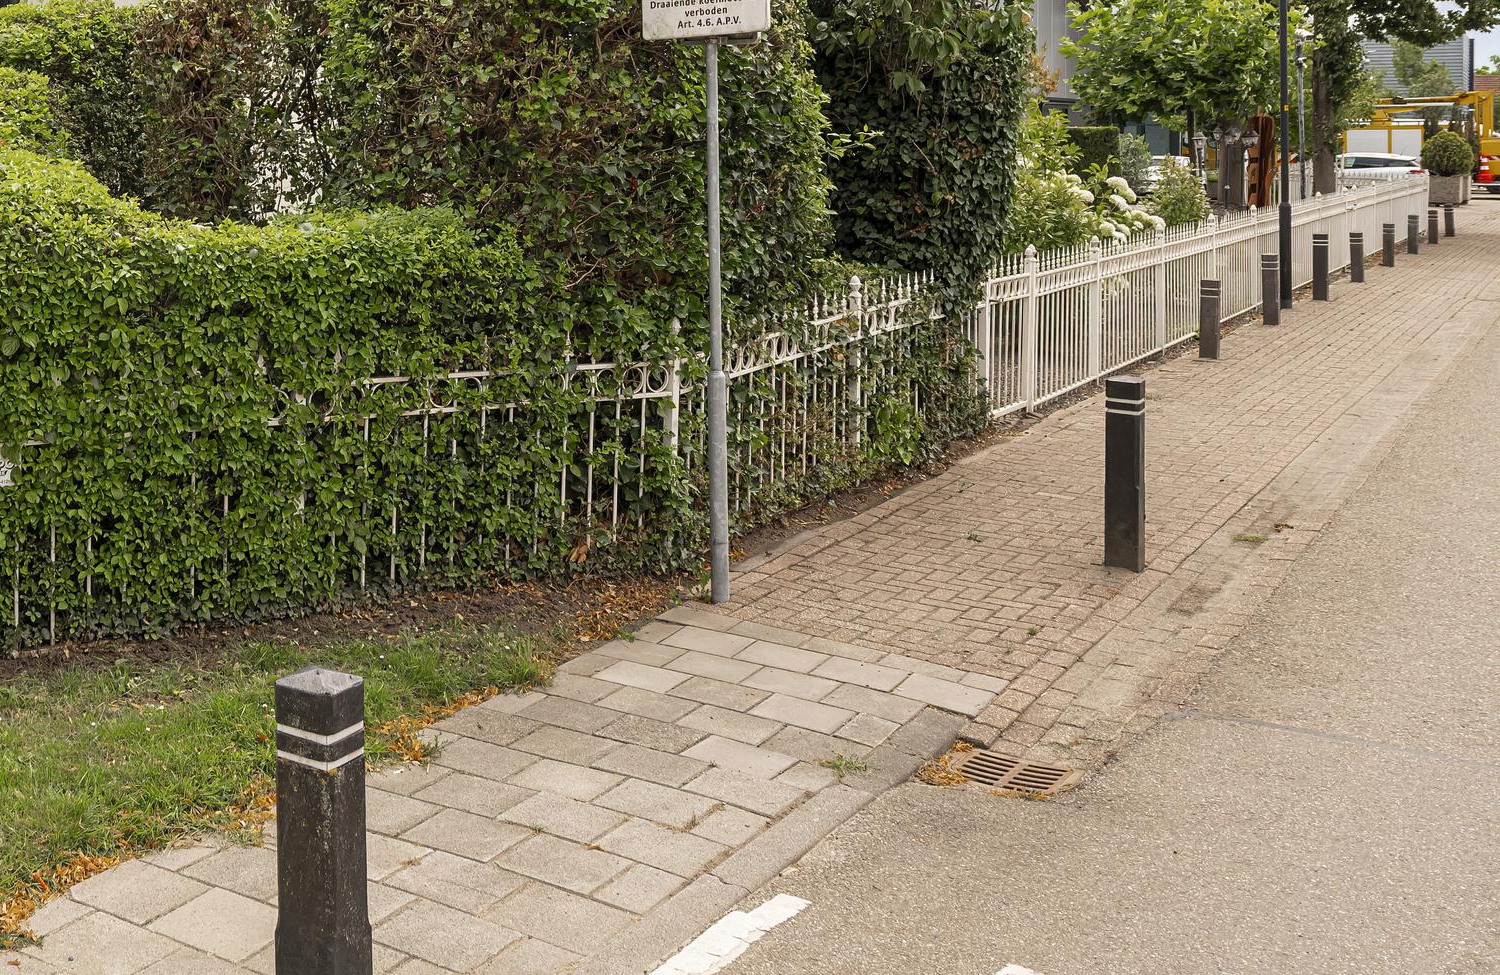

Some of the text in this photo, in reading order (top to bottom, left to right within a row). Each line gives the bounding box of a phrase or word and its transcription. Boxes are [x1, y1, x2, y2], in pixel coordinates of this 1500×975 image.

[684, 6, 728, 17] verboden
[677, 16, 742, 29] Art. 4.6. A.P.V.
